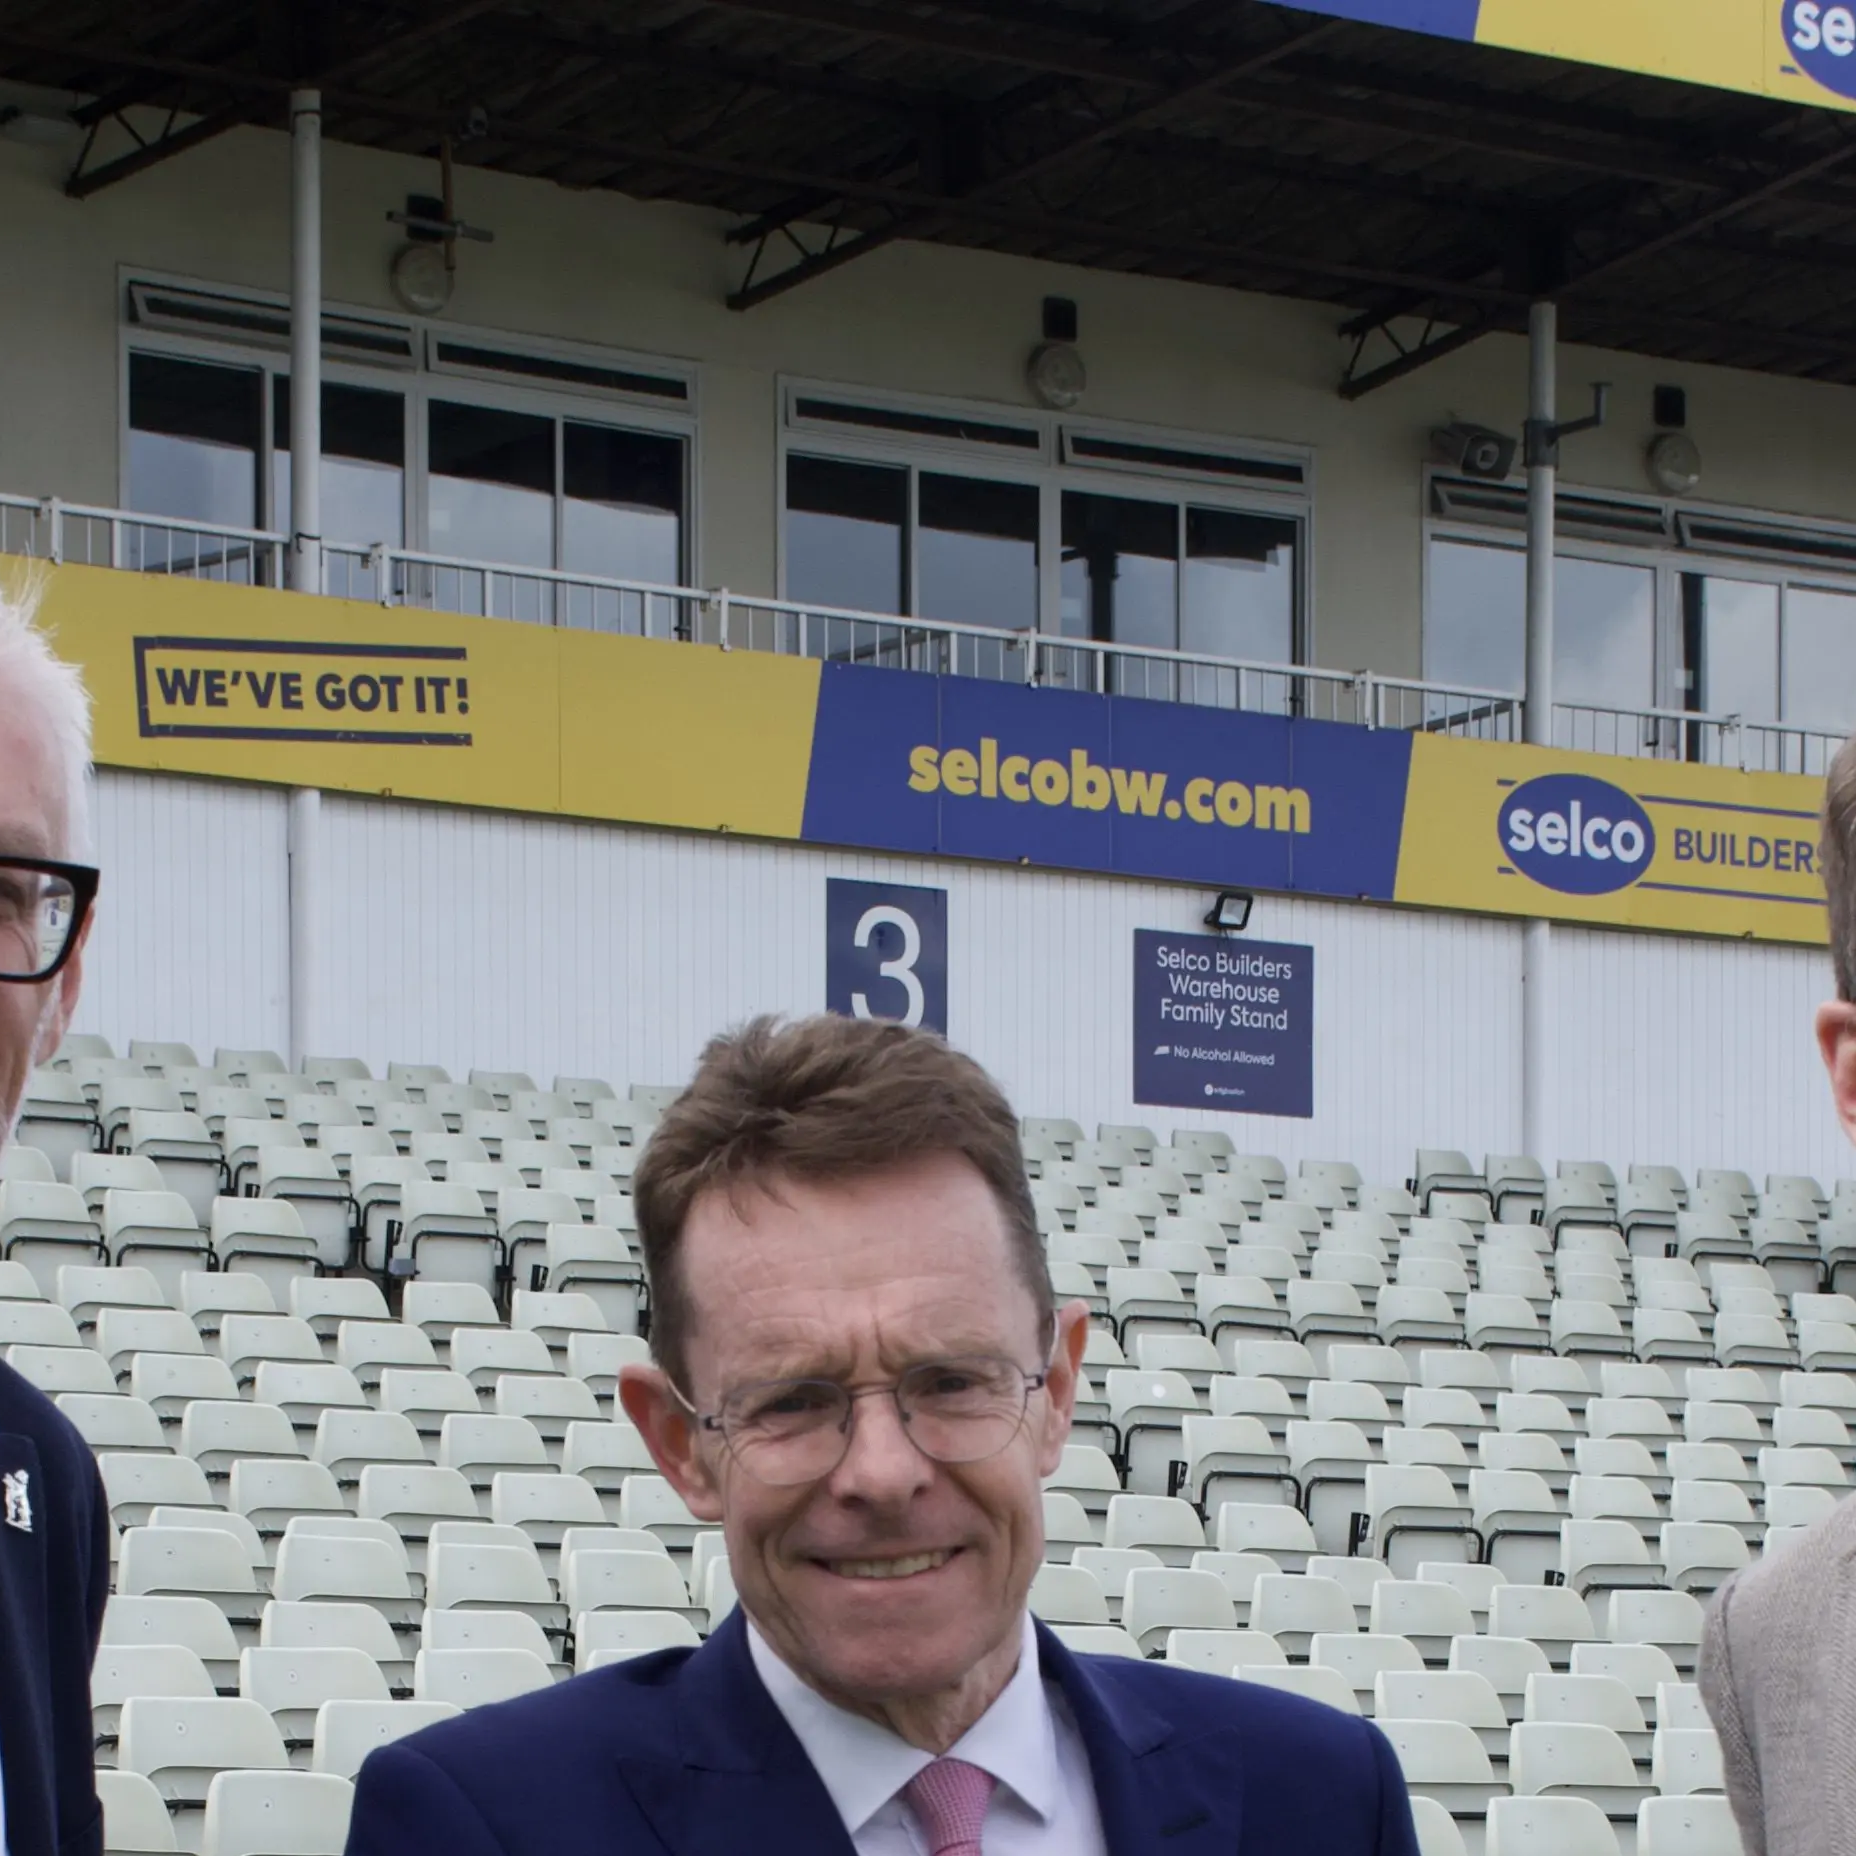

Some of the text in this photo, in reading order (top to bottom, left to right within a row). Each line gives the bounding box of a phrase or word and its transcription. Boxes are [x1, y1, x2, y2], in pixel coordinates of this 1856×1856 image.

[156, 668, 469, 715] WE'VE GOT IT!
[907, 736, 1312, 834] selcobw.com
[1507, 800, 1814, 874] selco BUILDER
[851, 905, 924, 1028] 3
[1157, 946, 1293, 980] Selco Builders
[1169, 973, 1280, 1004] Warehouse
[1161, 998, 1288, 1030] Family Stand
[1174, 1045, 1275, 1066] No Alcohol Allowed
